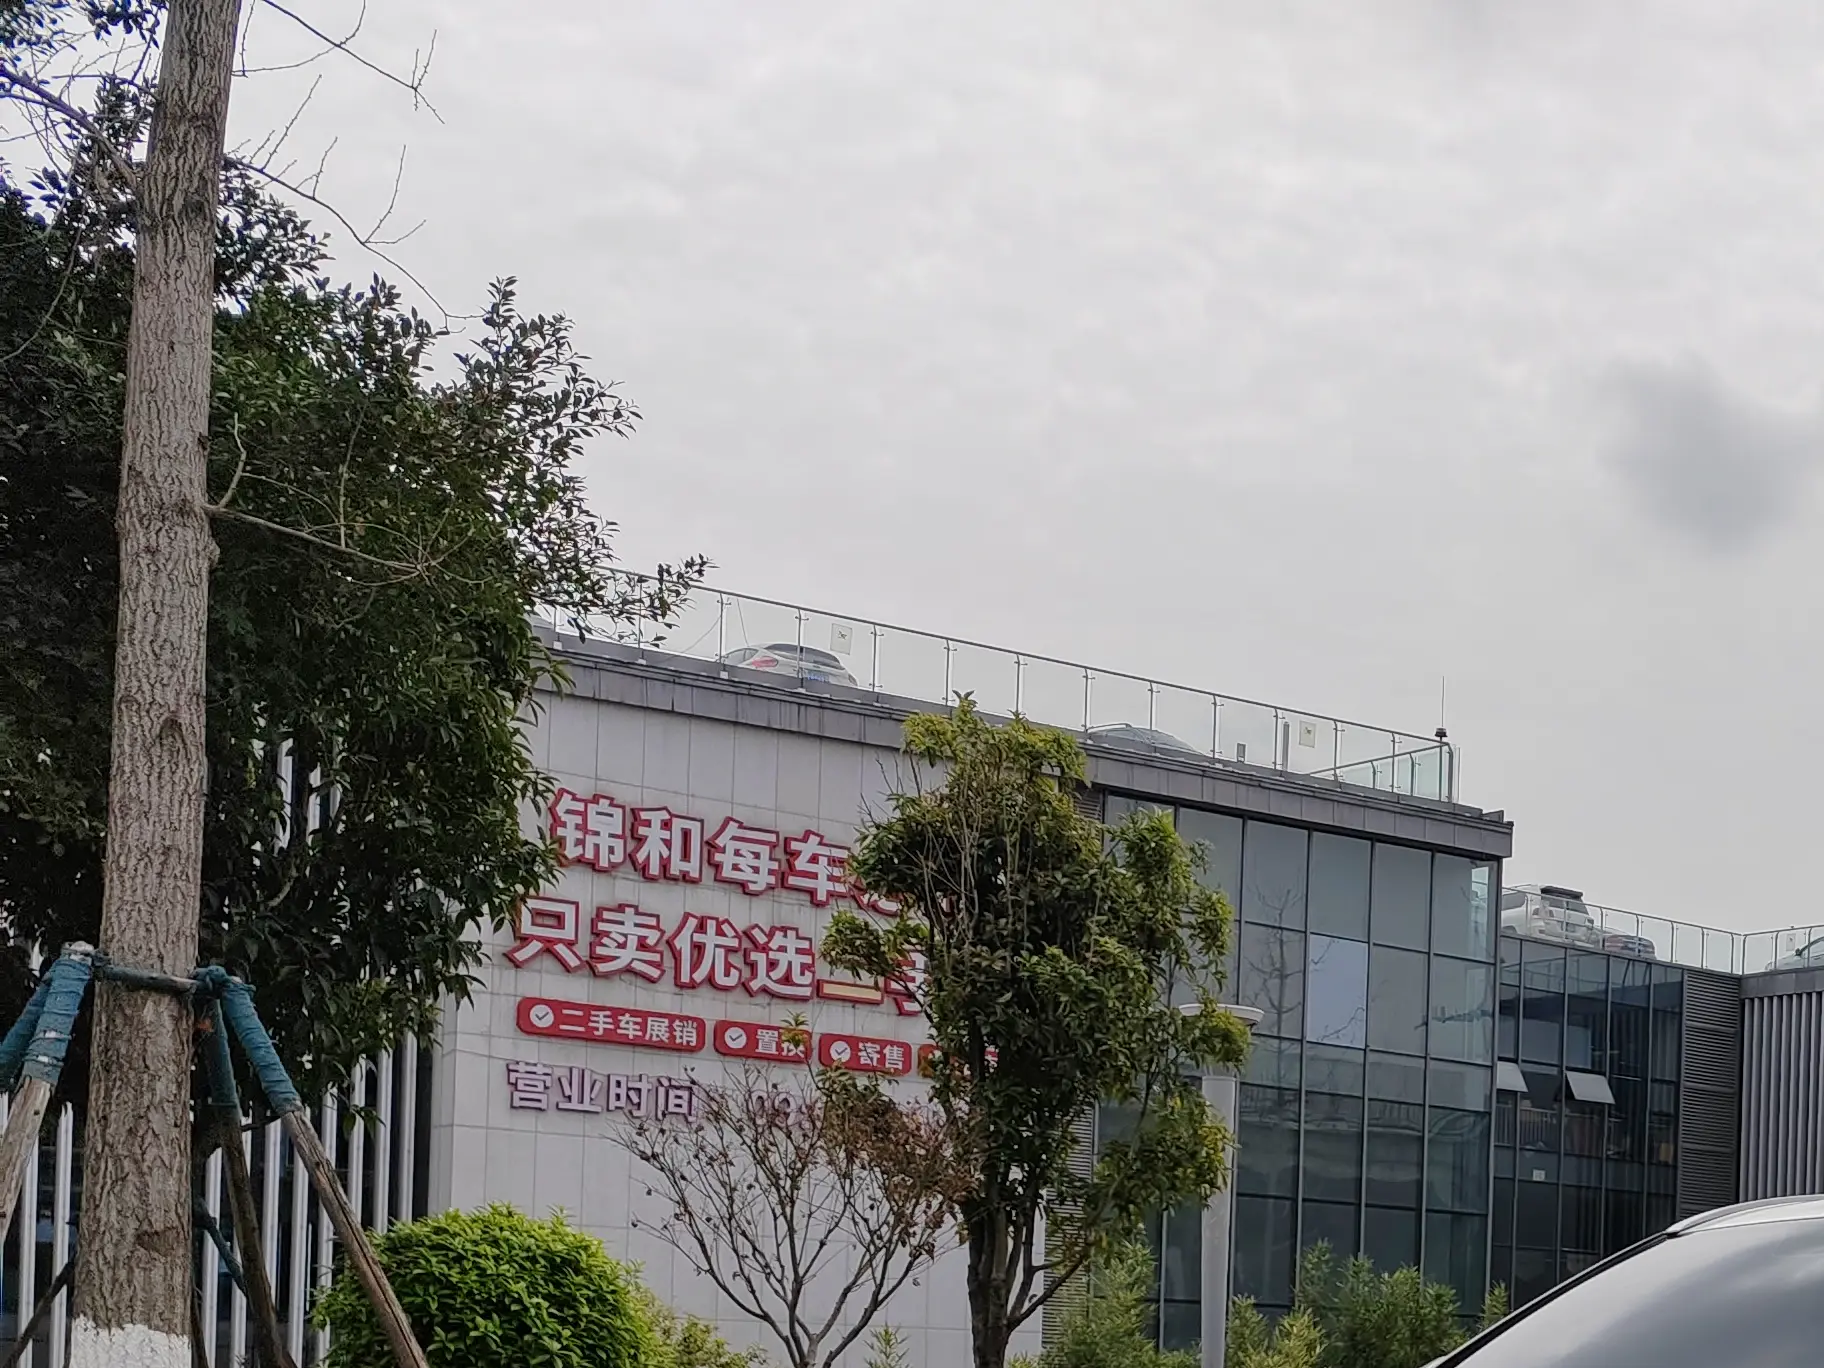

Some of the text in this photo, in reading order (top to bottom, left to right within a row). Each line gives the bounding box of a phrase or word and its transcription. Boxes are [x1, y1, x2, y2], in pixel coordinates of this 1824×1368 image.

[550, 788, 902, 916] 锦和每车
[559, 1009, 698, 1046] 二手车展销
[858, 1041, 906, 1070] 寄售
[507, 1062, 701, 1124] 营业时间
